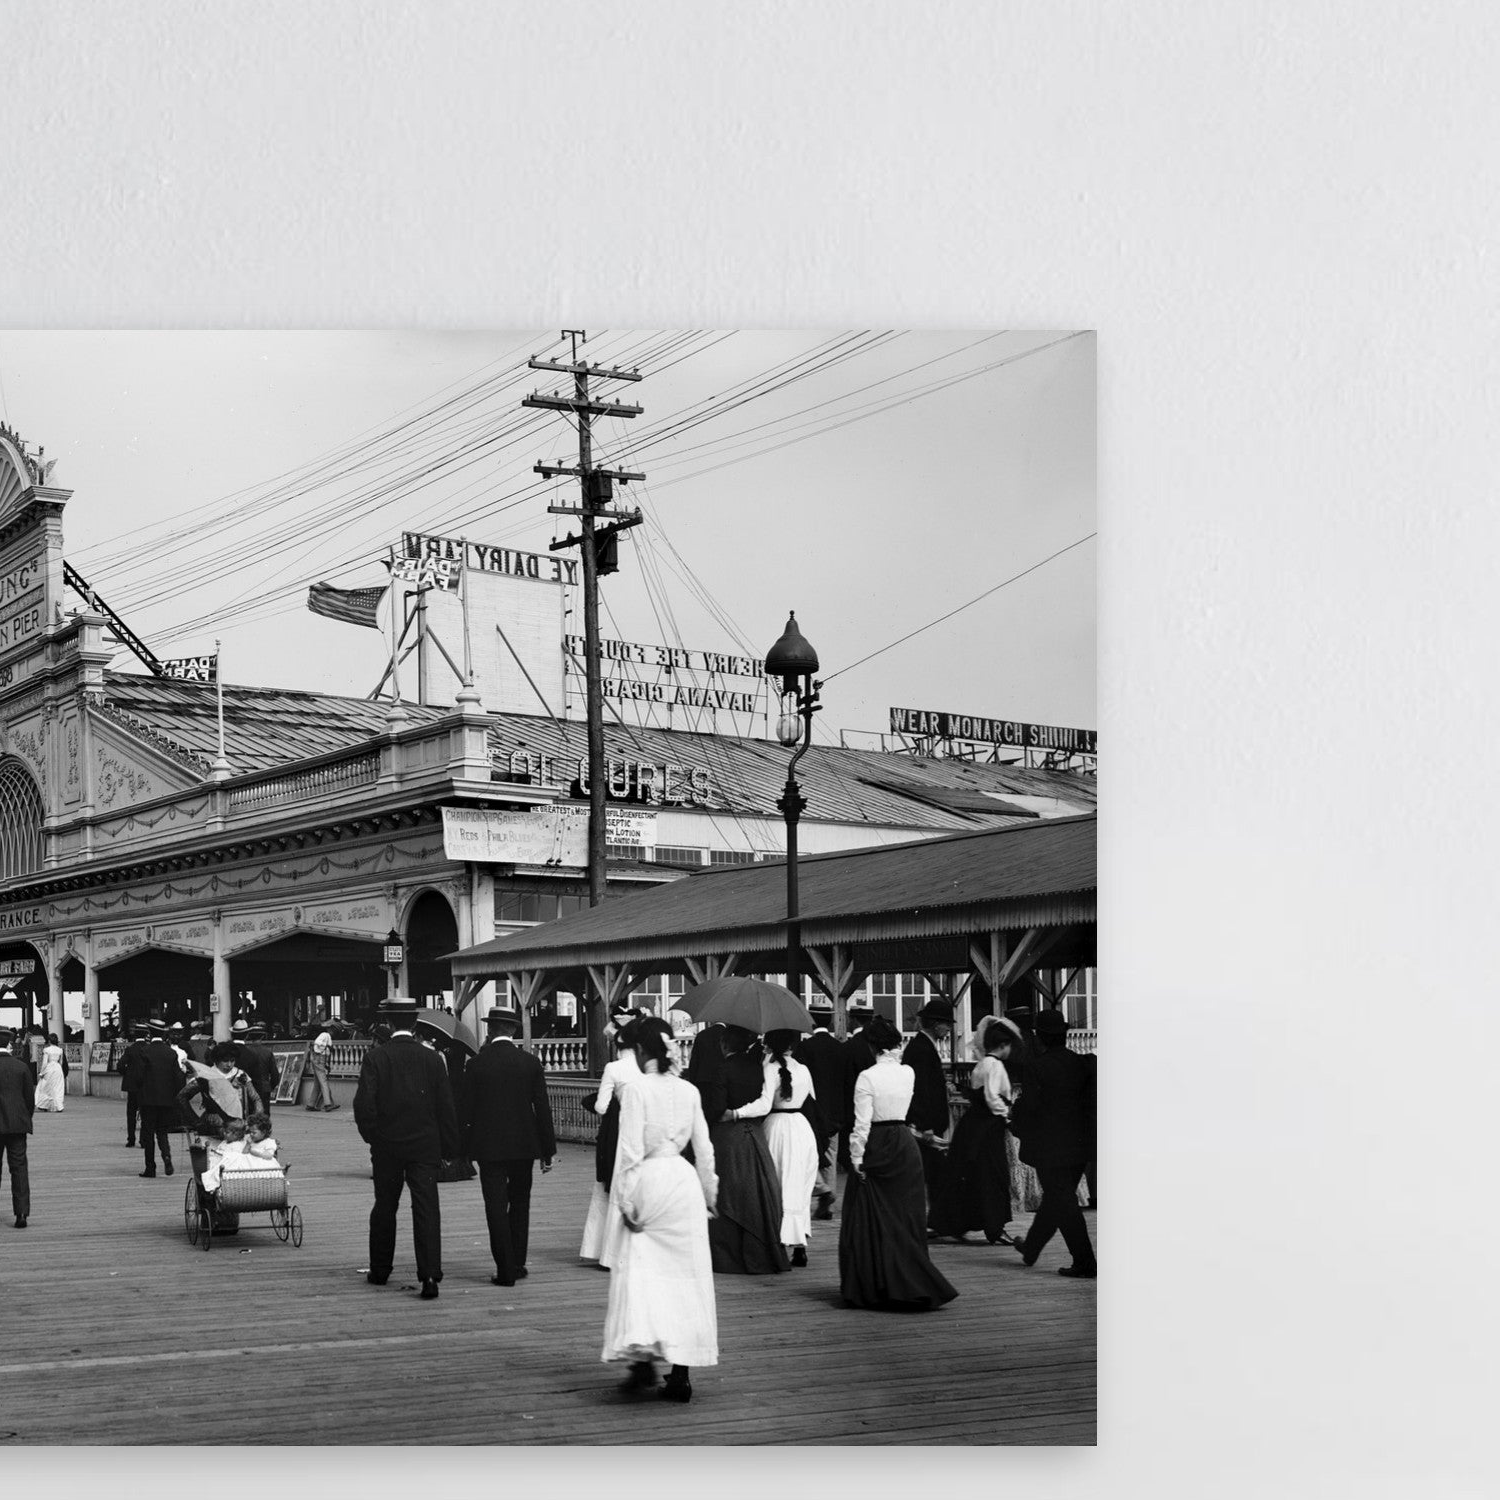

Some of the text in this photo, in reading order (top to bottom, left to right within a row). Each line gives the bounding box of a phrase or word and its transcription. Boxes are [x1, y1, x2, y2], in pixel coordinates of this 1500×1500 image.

[13, 609, 39, 640] PIER
[893, 708, 940, 734] WEAR
[949, 715, 1023, 744] MONARCH
[539, 805, 570, 815] GREATEST
[616, 828, 641, 837] LOTION
[606, 837, 630, 845] TLANTIC
